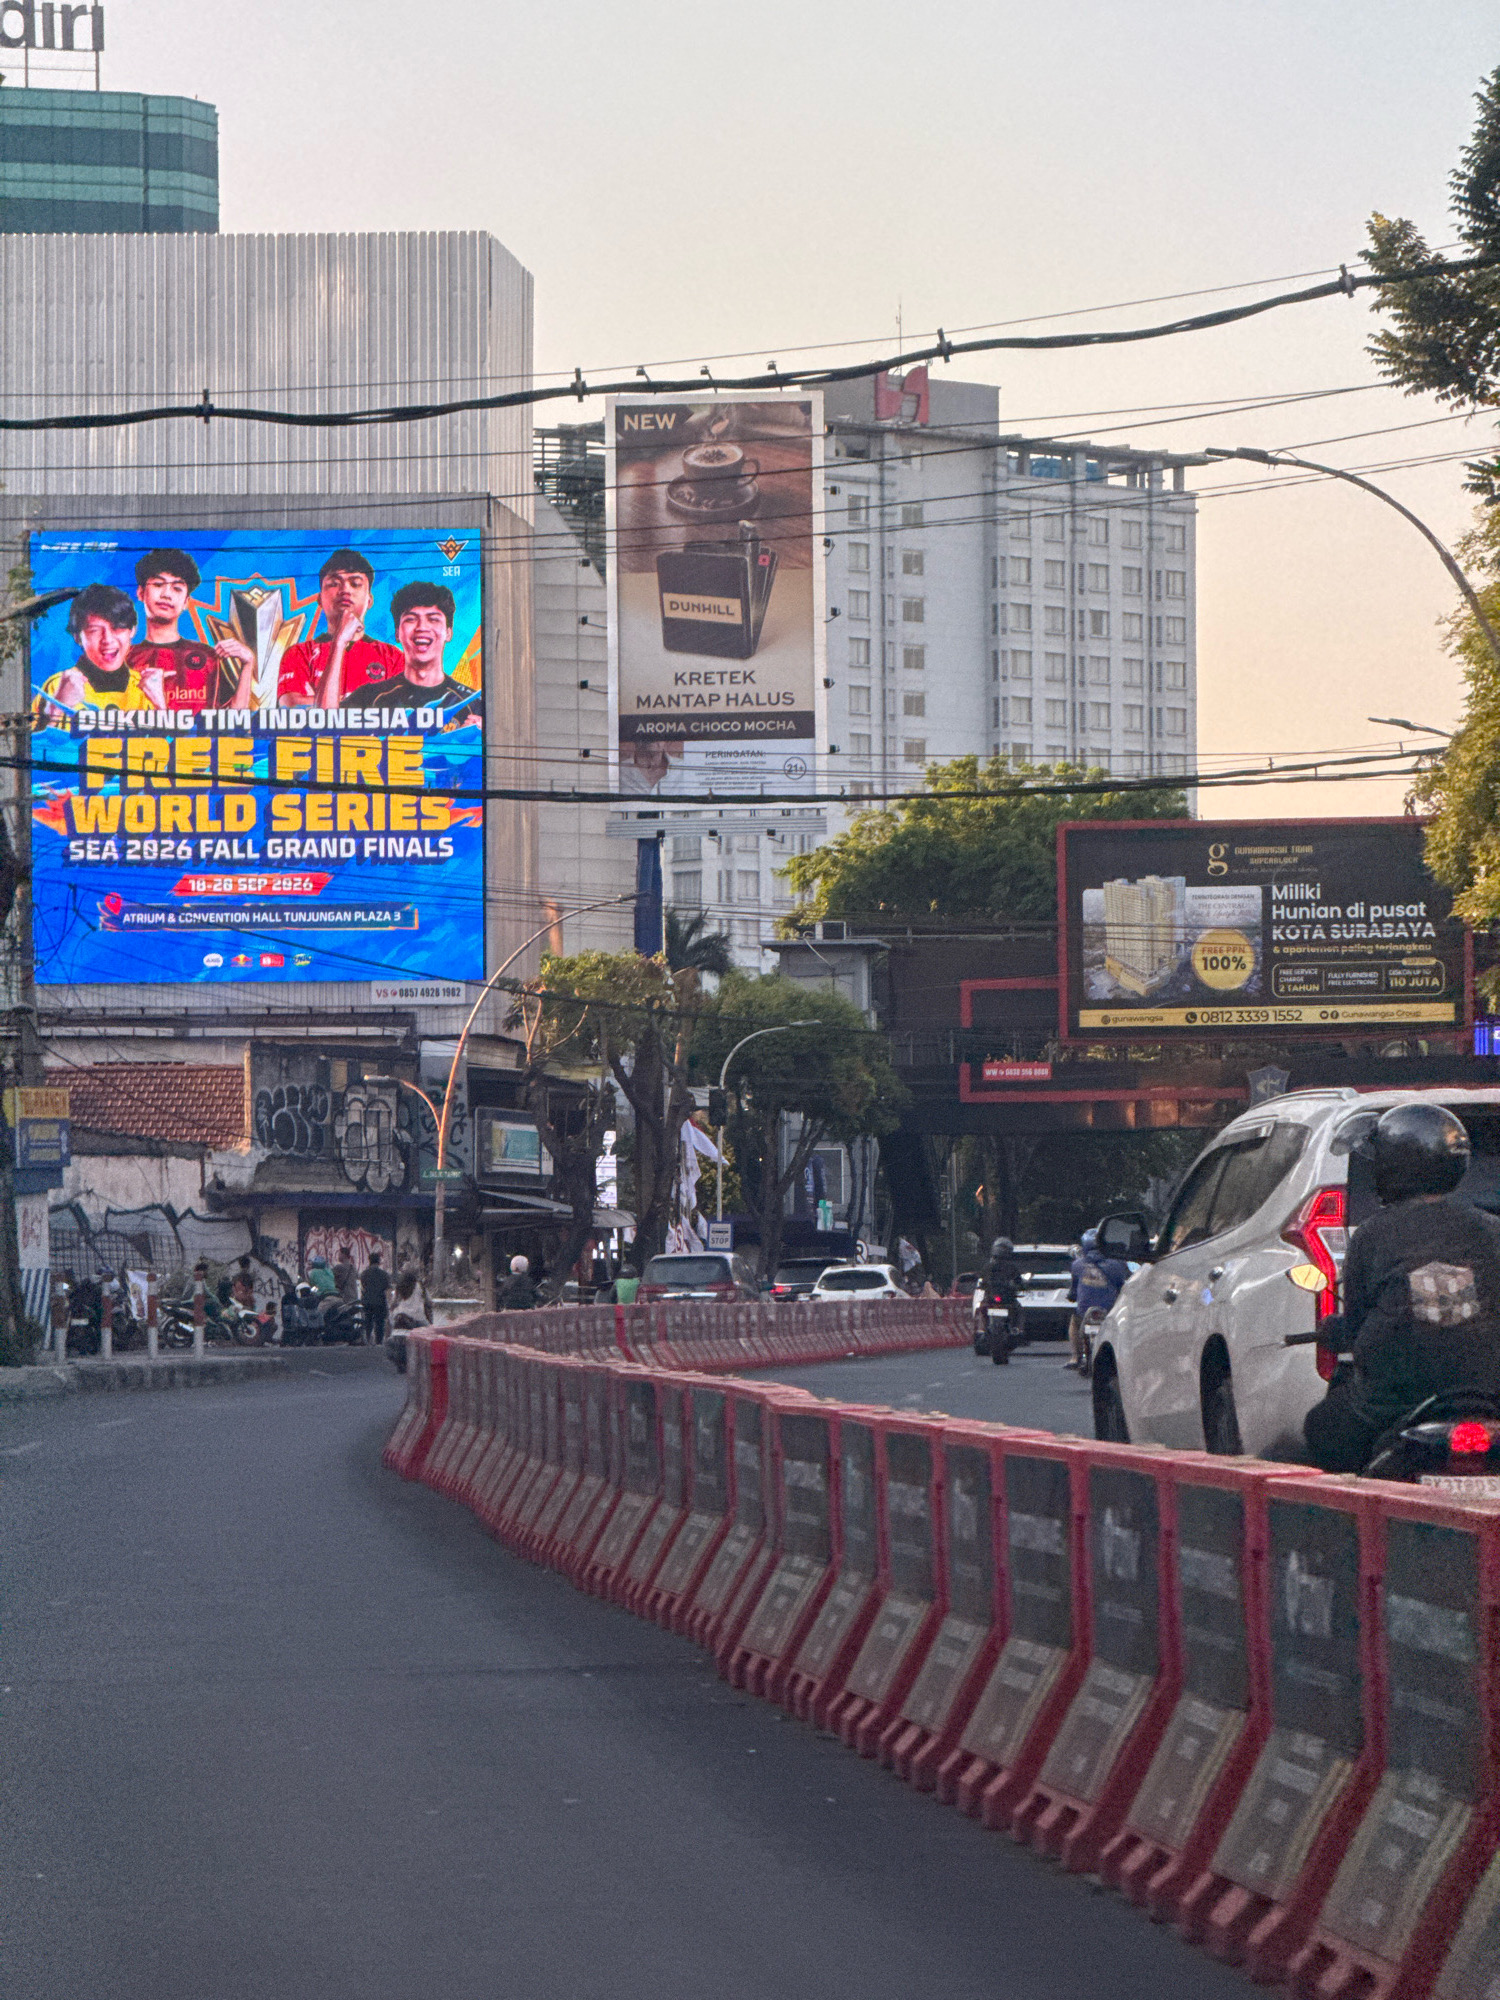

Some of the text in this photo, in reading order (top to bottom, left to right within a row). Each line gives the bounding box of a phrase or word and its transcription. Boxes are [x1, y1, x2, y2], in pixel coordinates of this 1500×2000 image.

[623, 413, 677, 431] NEW
[442, 565, 461, 577] SEA
[669, 599, 735, 617] DUNHILL
[674, 670, 756, 686] KRETEK
[635, 691, 796, 709] MANTAP HALUS
[78, 708, 444, 731] DUKUNG TIM INDONESIA DI
[636, 720, 797, 734] AROMA CHOCO MOCHA
[86, 735, 425, 788] FREE FIRE
[786, 763, 805, 773] 21+
[70, 793, 451, 834] WORLD SERIES
[69, 837, 454, 861] SEA 2026 FALL GRAND FINALS
[237, 878, 268, 891] SEP
[271, 877, 314, 891] 2026
[1272, 883, 1321, 900] Miliki
[123, 910, 401, 924] ATRIUM & CONVENTION HALL TUNJUNGAN PLAZA 3
[1272, 903, 1341, 920] Hunian
[1346, 902, 1365, 918] di
[1370, 902, 1427, 923] pusat
[1272, 922, 1437, 941] KOTA SURABAYA
[1226, 946, 1246, 954] PPN
[1202, 956, 1247, 971] 100%
[1279, 984, 1320, 992] 2 TAHUN
[1408, 977, 1440, 987] JUTA
[376, 988, 389, 997] VS
[1200, 1012, 1233, 1024] 0812
[1236, 1011, 1269, 1023] 3339
[1273, 1010, 1303, 1022] 1552
[711, 1237, 729, 1245] STOP
